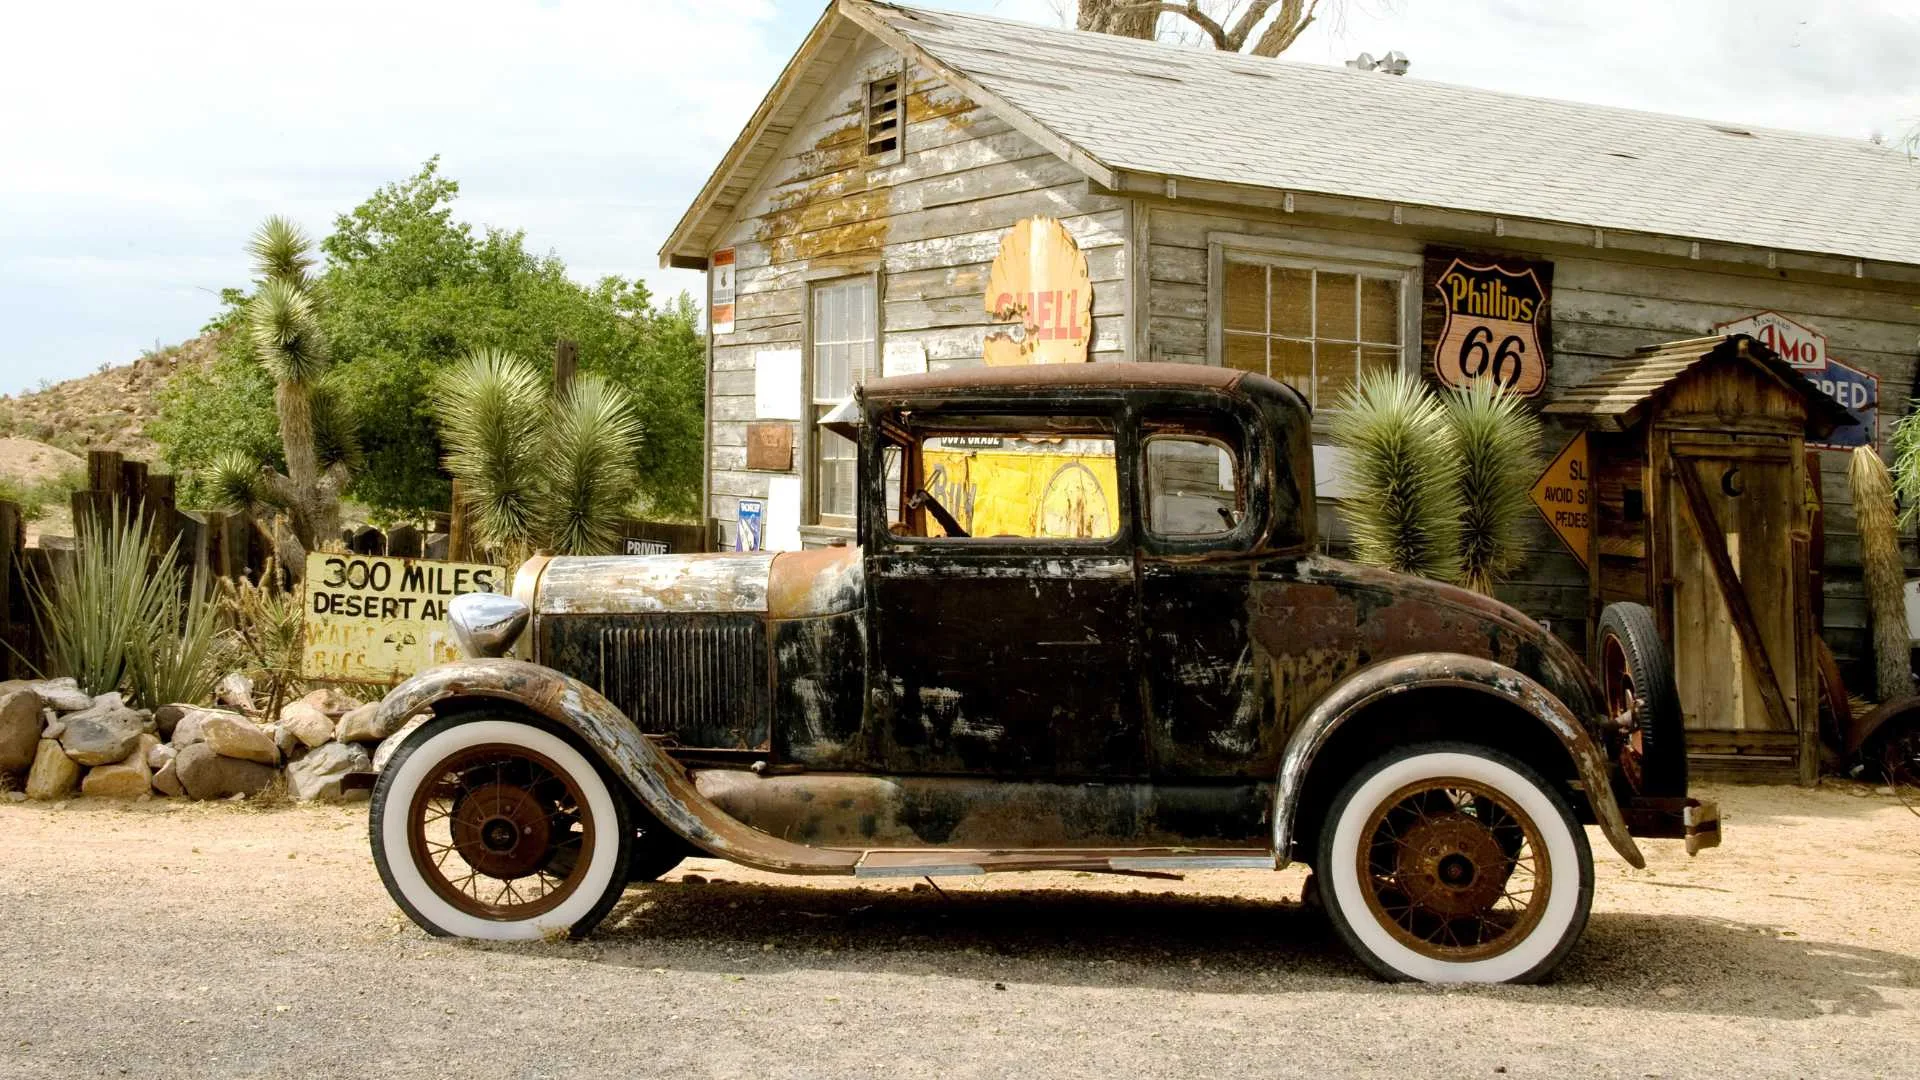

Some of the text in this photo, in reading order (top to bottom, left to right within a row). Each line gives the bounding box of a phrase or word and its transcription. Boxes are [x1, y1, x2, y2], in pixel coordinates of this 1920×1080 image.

[1446, 273, 1533, 322] Phillips
[1459, 326, 1525, 388] 66
[1759, 324, 1817, 363] AMO
[1569, 460, 1587, 480] SL
[1544, 486, 1573, 503] AVOID
[1555, 511, 1588, 529] PEDES
[627, 540, 668, 555] PRIVATE
[323, 558, 493, 594] 300 MILES
[313, 592, 448, 621] DESERT AH
